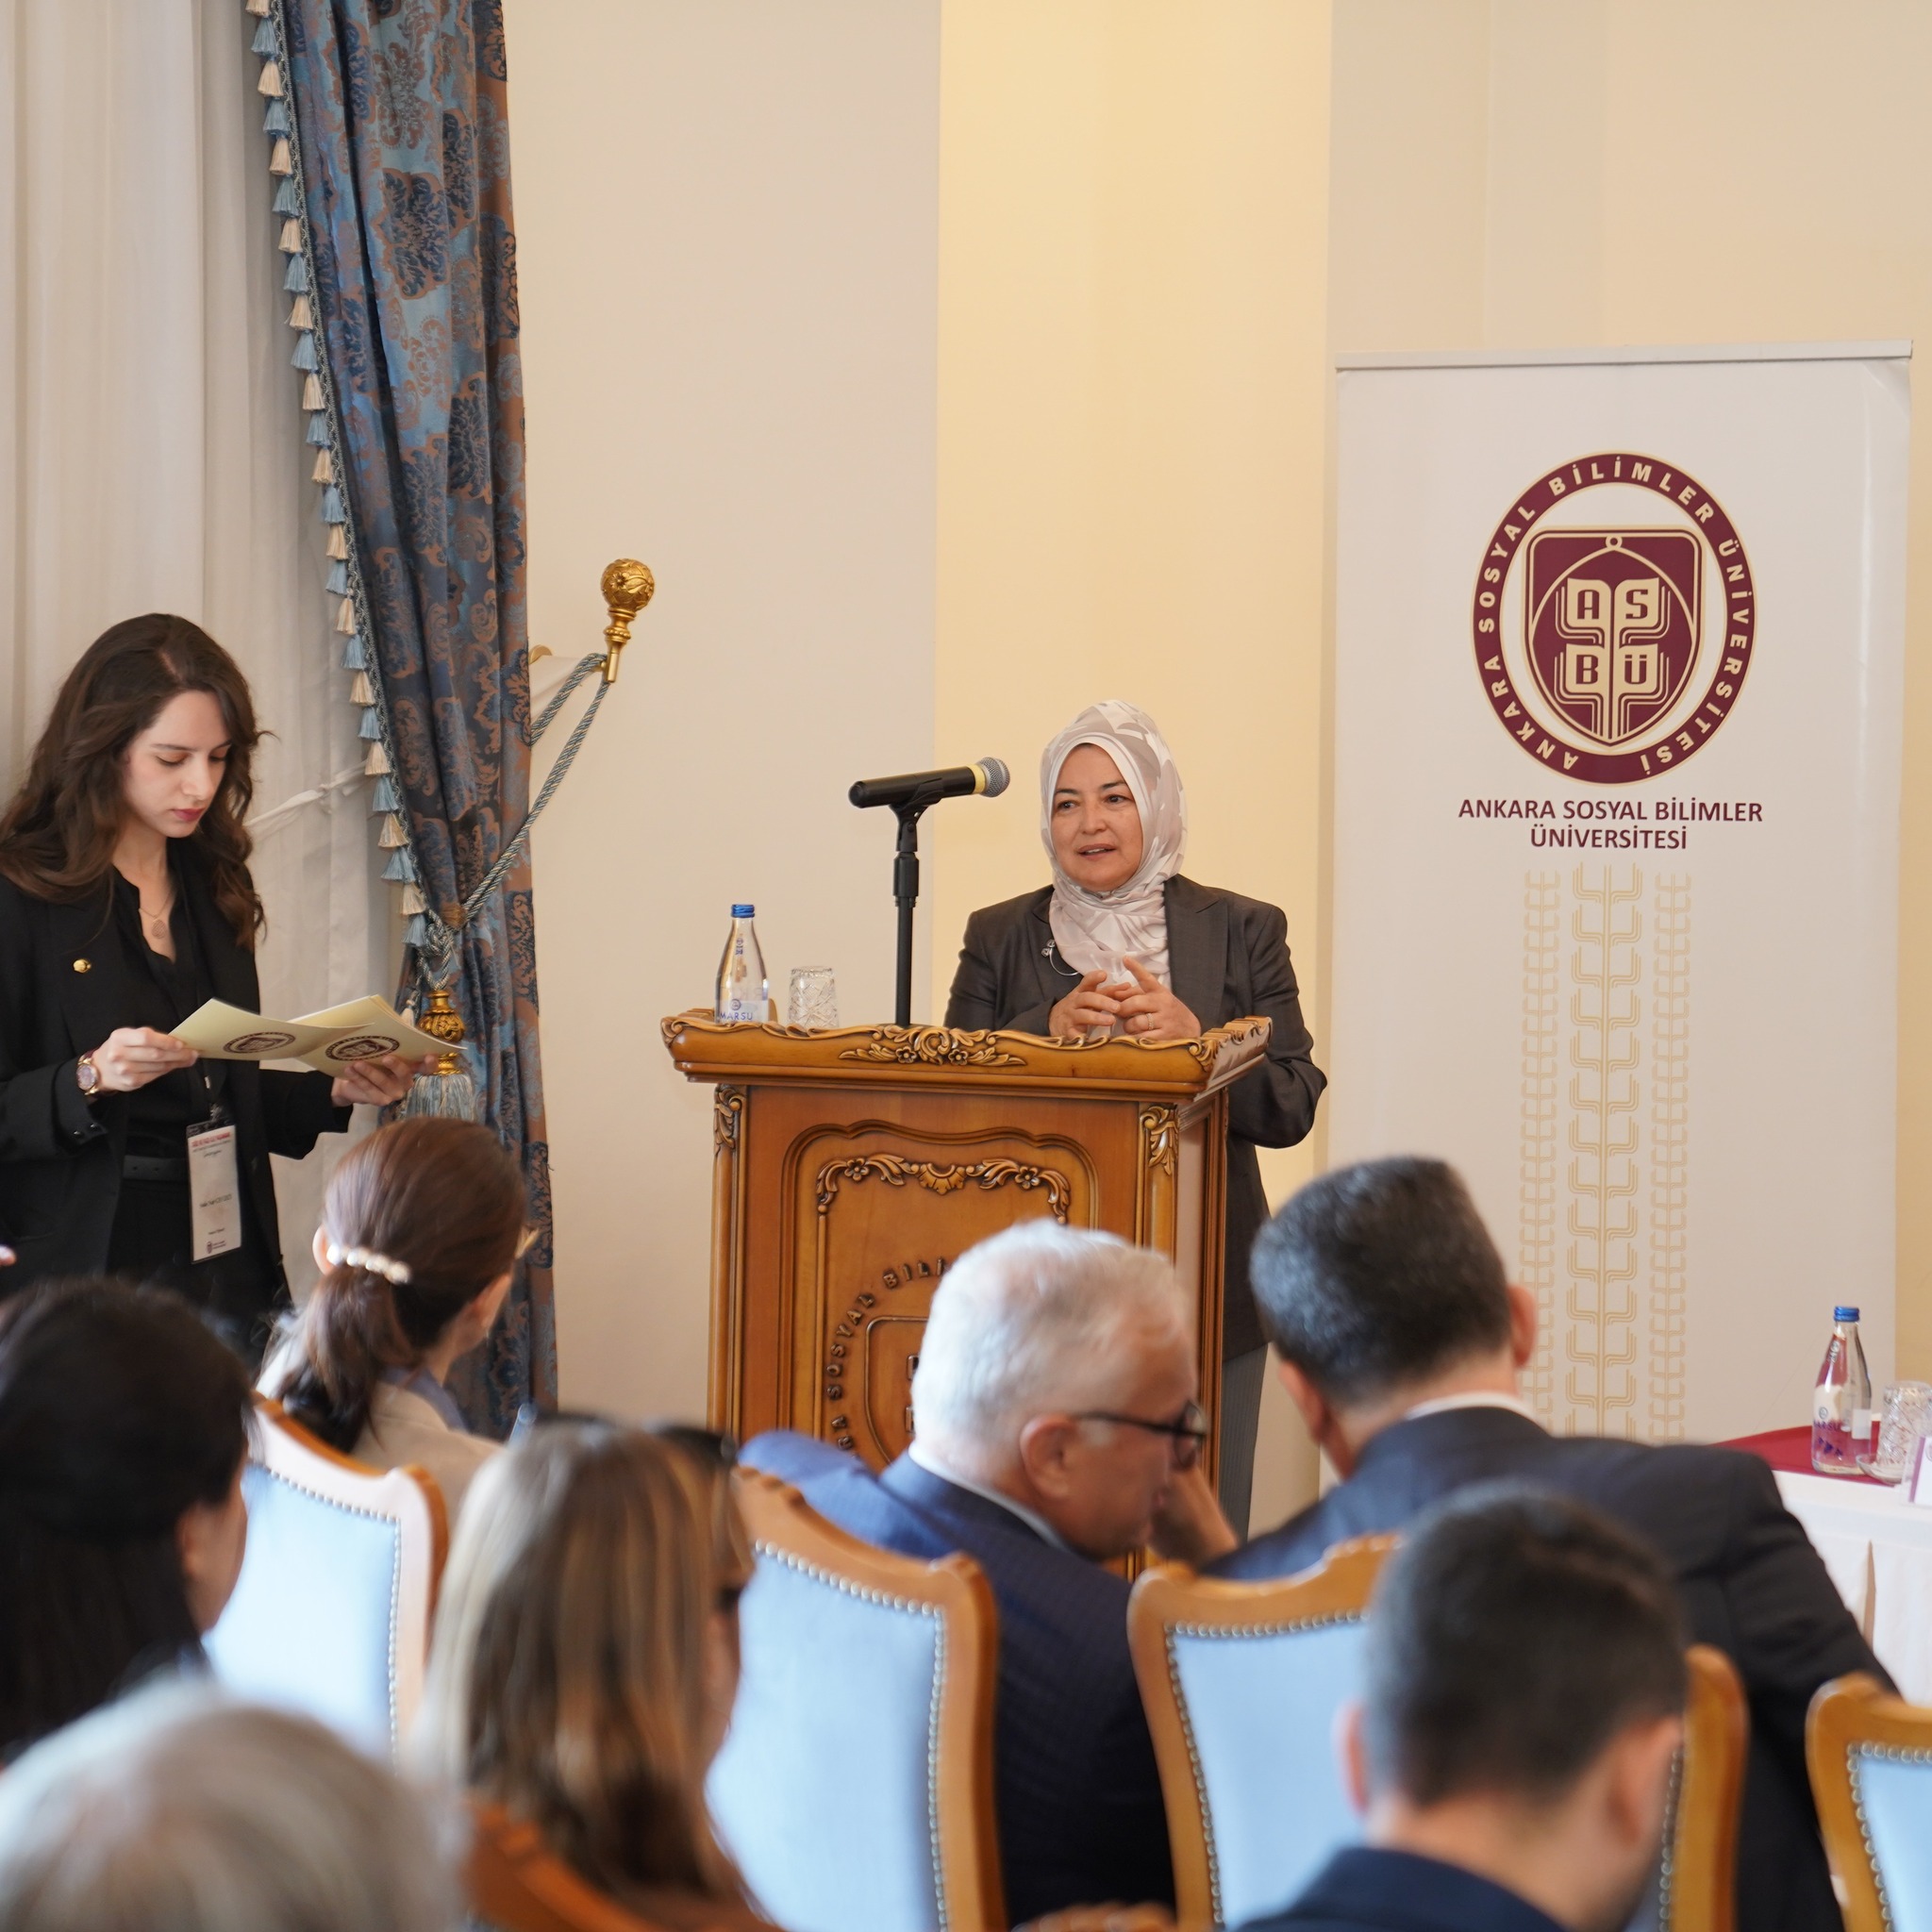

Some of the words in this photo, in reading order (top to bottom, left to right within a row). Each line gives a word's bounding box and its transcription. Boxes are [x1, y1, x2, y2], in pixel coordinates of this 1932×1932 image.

[1548, 456, 1714, 524] BİLİMLER
[1478, 506, 1536, 634] SOSYAL
[1641, 539, 1754, 776] ÜNİVERSİTESİ
[1485, 655, 1578, 772] ANKARA
[1458, 799, 1556, 820] ANKARA
[1563, 800, 1647, 821] SOSYAL
[1656, 797, 1763, 823] BİLİMLER
[1530, 824, 1688, 850] ÜNİVERSİTESİ
[720, 1012, 753, 1021] MARSU
[826, 1292, 875, 1402] SOSYAL
